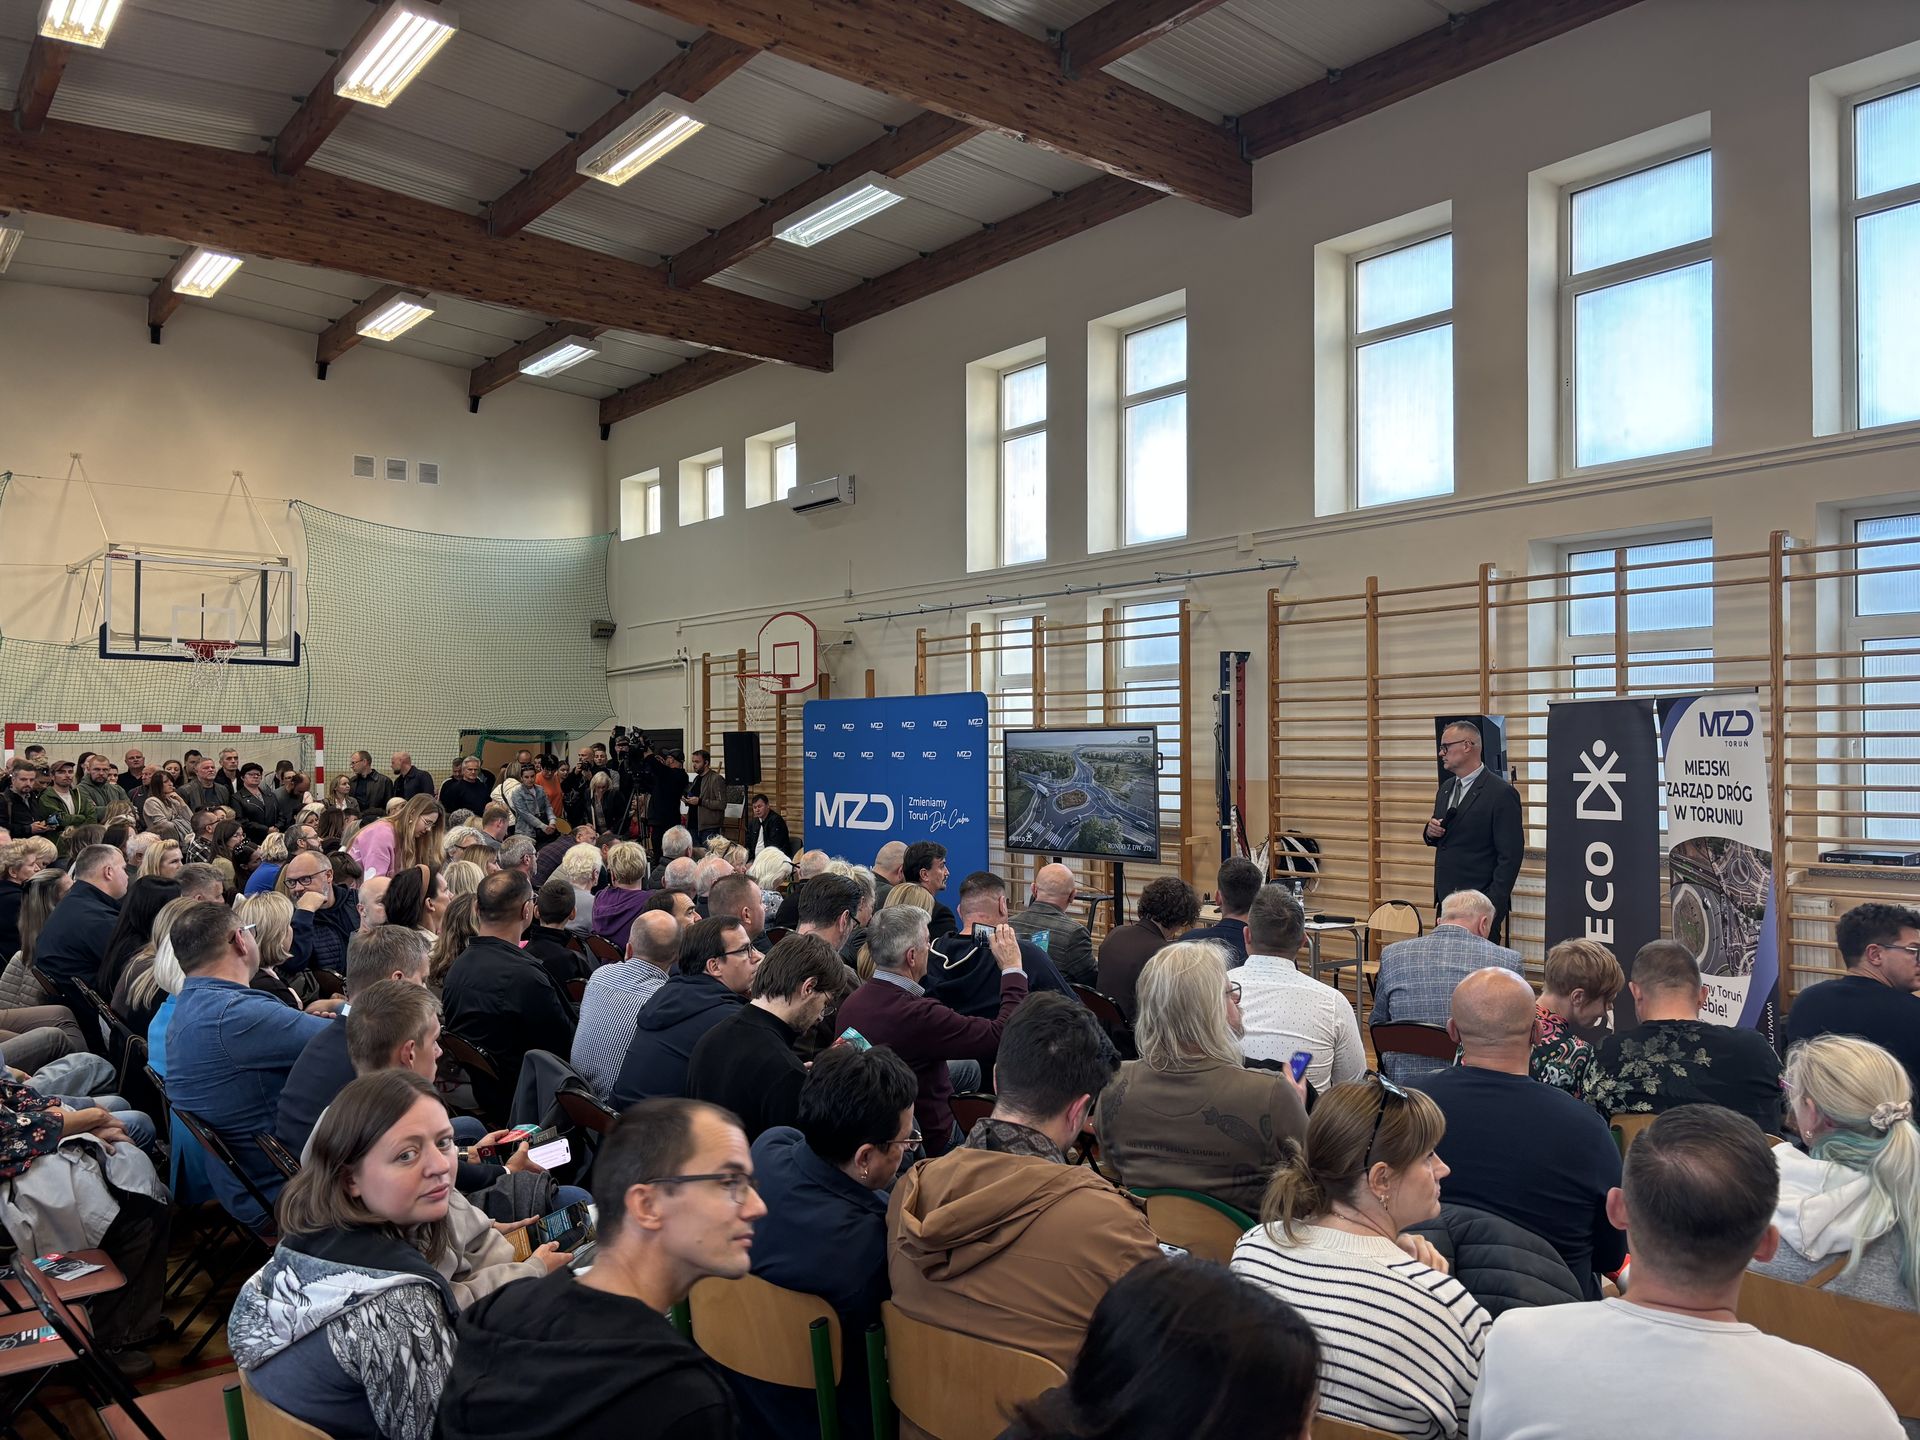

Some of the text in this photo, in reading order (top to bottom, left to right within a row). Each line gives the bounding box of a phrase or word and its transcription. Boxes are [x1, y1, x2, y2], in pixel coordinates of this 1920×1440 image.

[968, 718, 983, 726] MZD
[1699, 710, 1754, 737] MZD
[1725, 739, 1749, 747] TORUŃ
[956, 750, 972, 758] MZD
[1684, 759, 1730, 777] MIEJSKI
[1667, 780, 1752, 804] ZARZĄD DRÓG
[815, 791, 895, 831] MZD
[908, 796, 947, 810] Zmieniamy
[908, 810, 928, 820] Toruń
[1674, 804, 1743, 826] W TORUNIU
[1585, 841, 1614, 945] ECO
[1717, 984, 1742, 1004] Toruń
[1702, 996, 1728, 1018] ebie!
